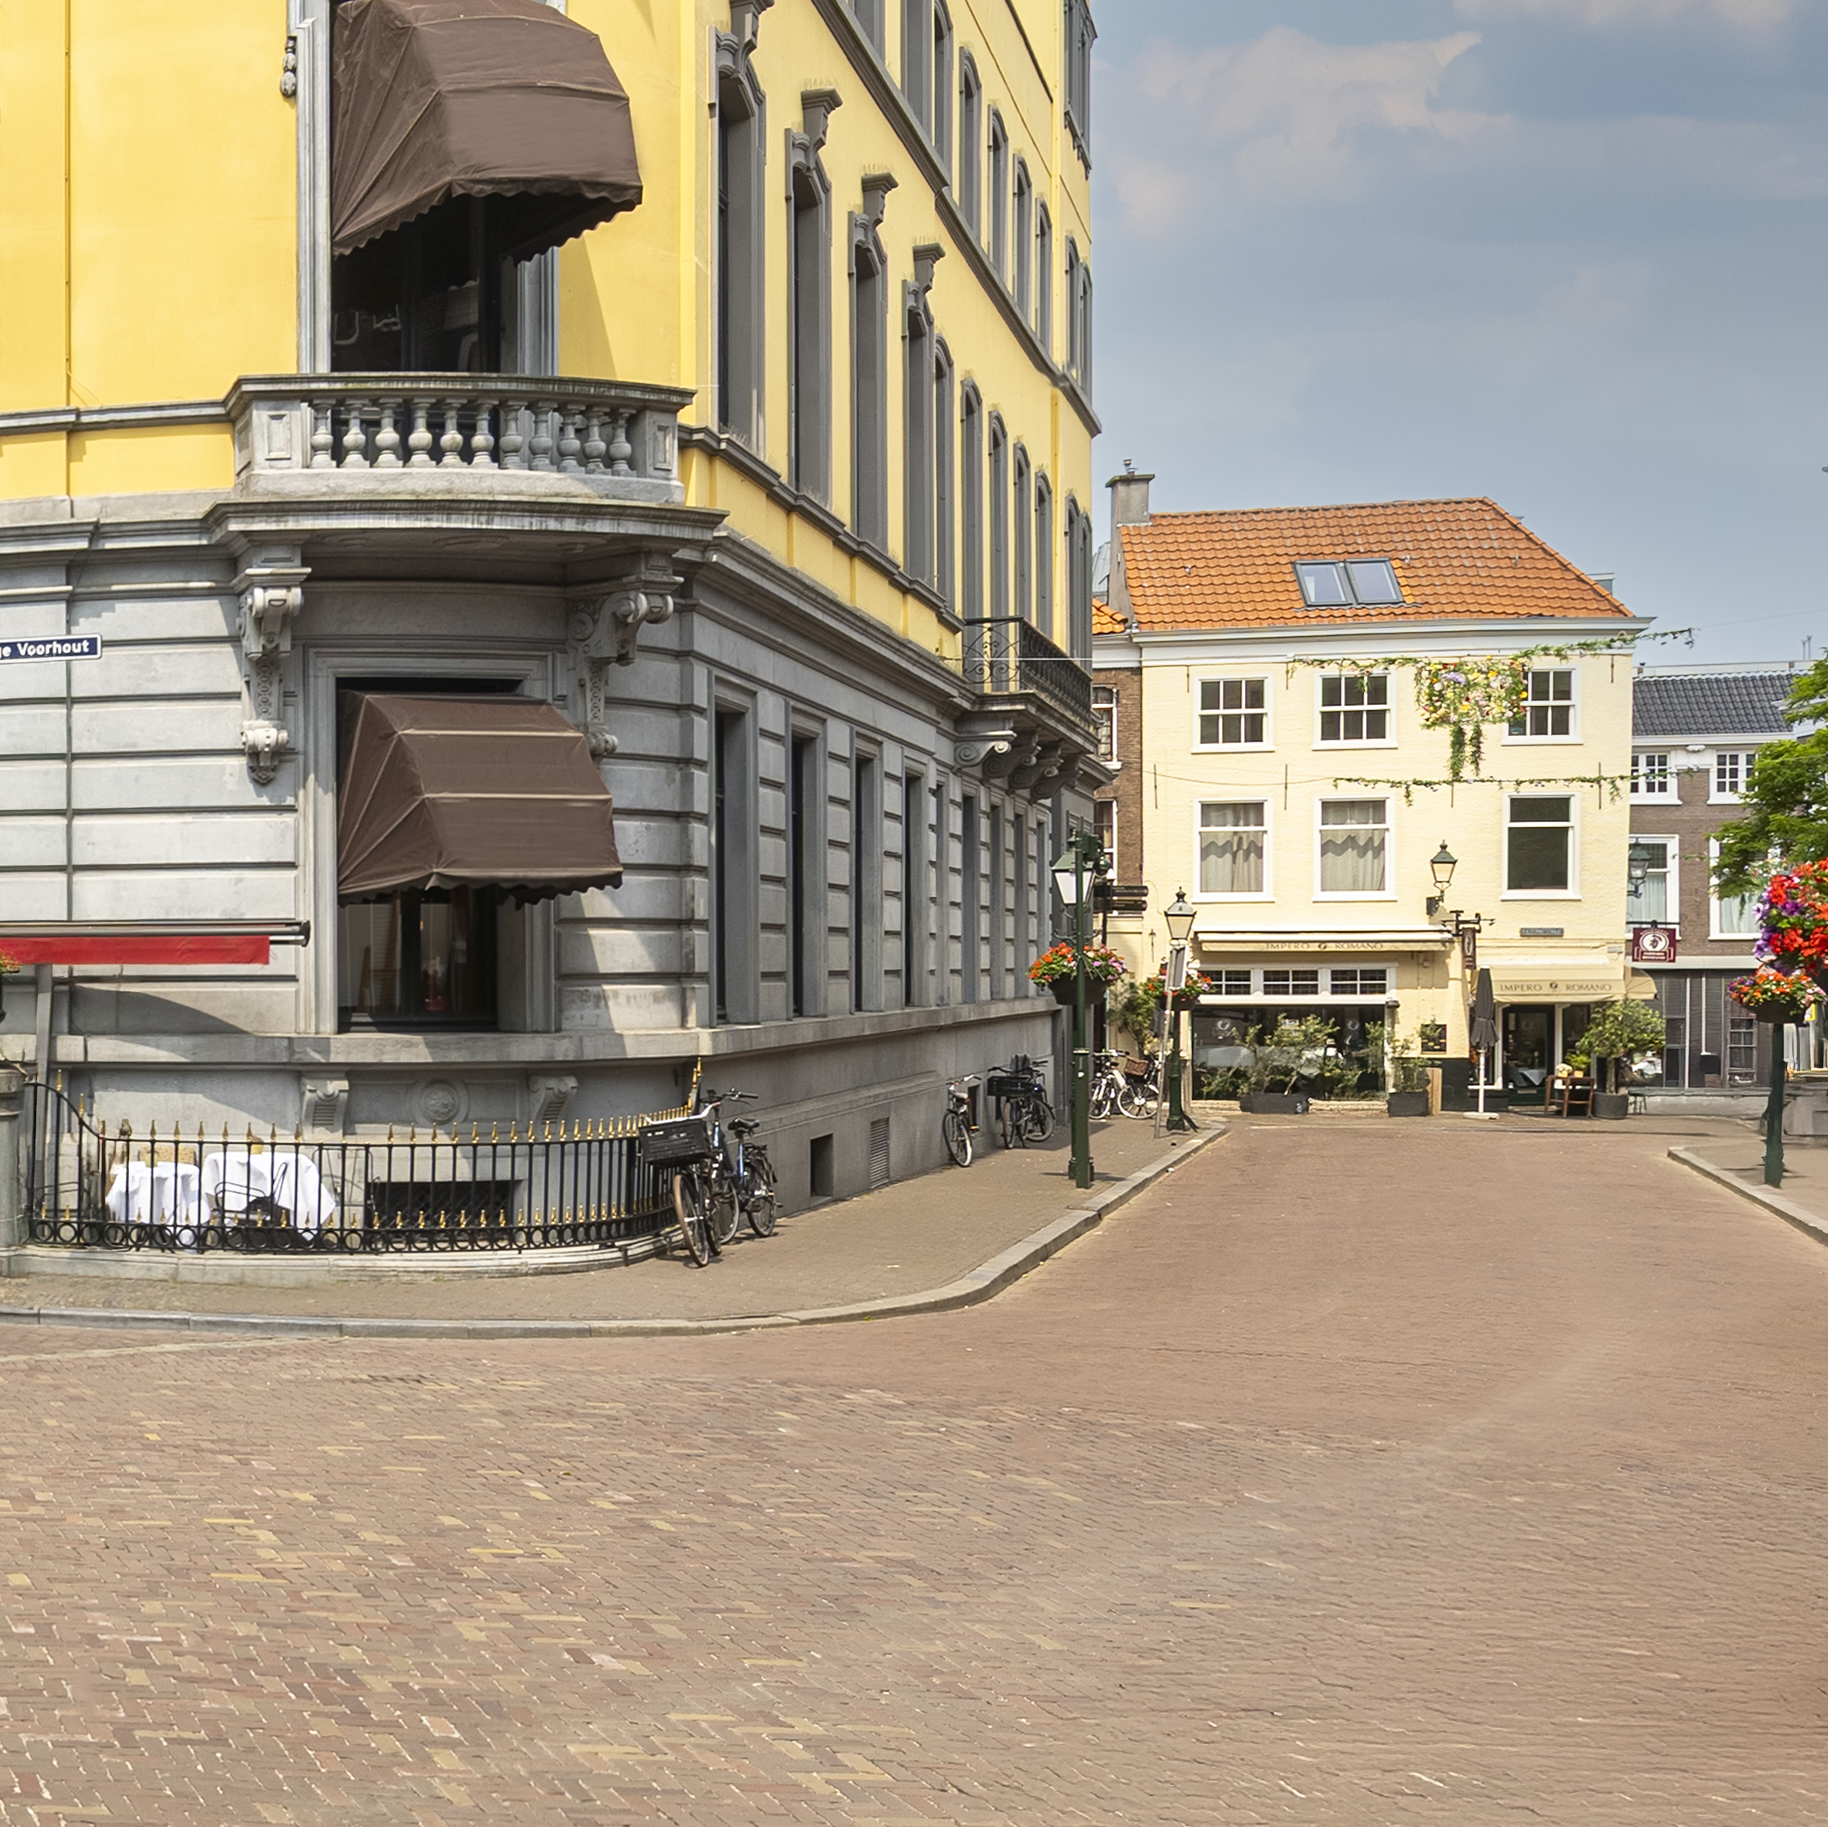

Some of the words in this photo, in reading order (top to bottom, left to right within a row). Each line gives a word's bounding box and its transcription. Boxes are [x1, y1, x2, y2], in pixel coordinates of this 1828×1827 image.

[17, 640, 89, 656] Voorhout
[1266, 942, 1310, 950] IMPERO
[1500, 984, 1542, 992] IMPERO
[1566, 983, 1612, 992] ROMANO
